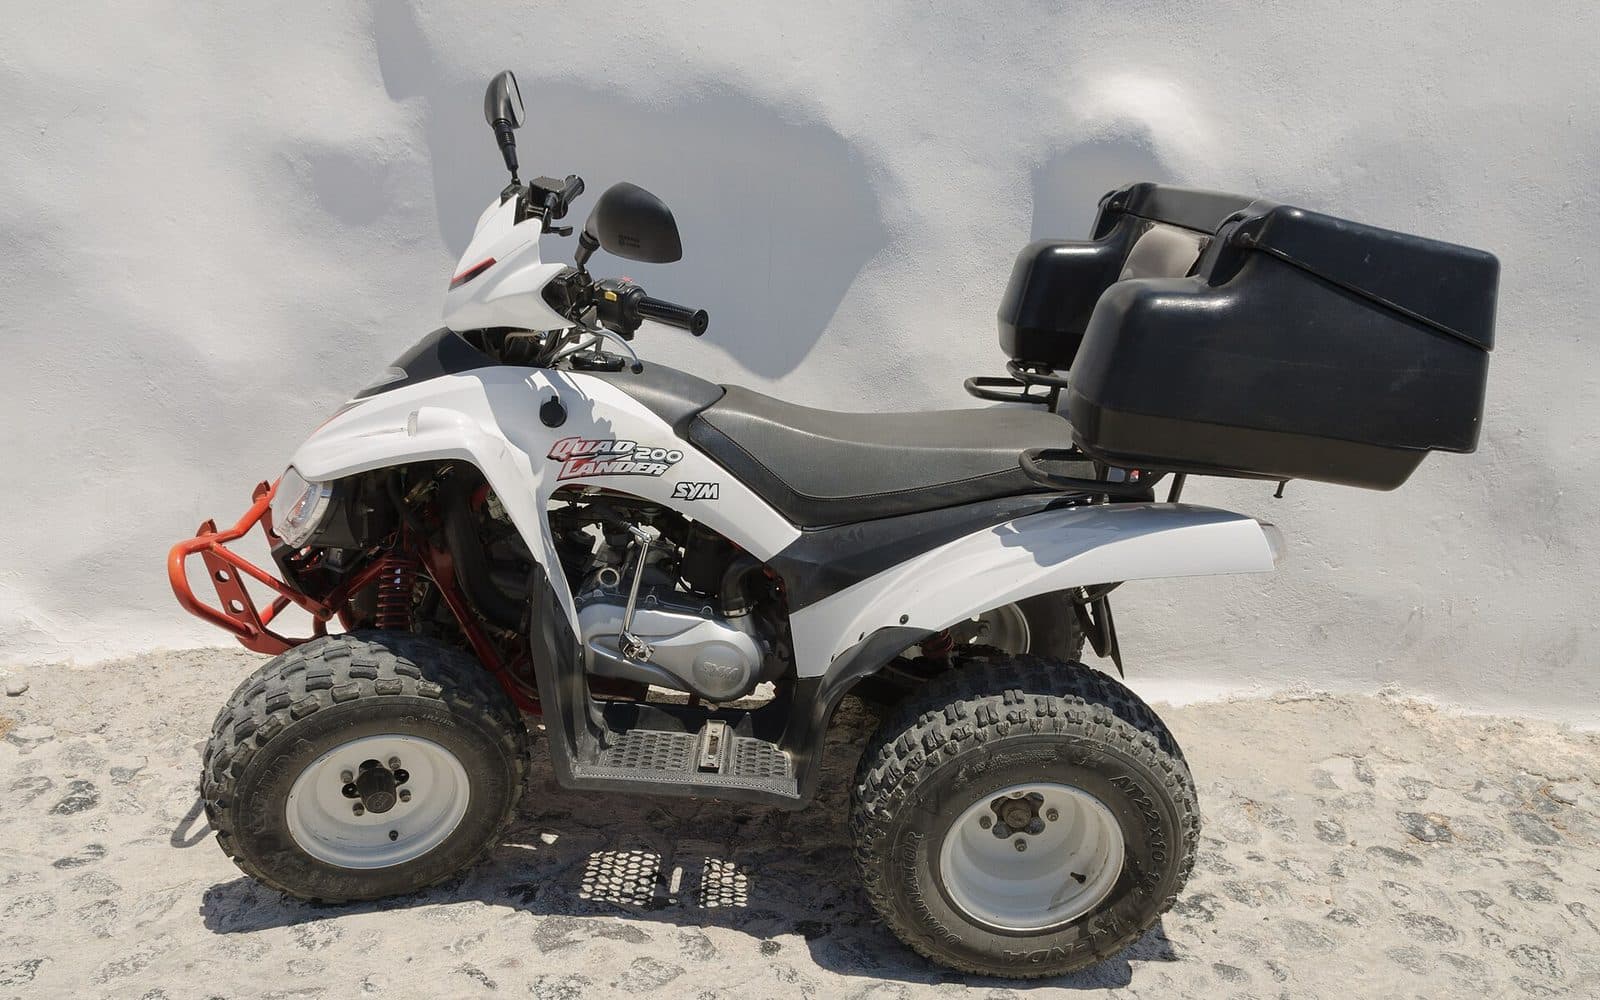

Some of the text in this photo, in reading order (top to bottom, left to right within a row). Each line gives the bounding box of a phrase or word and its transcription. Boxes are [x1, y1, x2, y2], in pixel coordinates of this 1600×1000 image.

[548, 436, 684, 463] QUAD 200
[557, 459, 672, 481] LANDER
[671, 482, 720, 501] SYM
